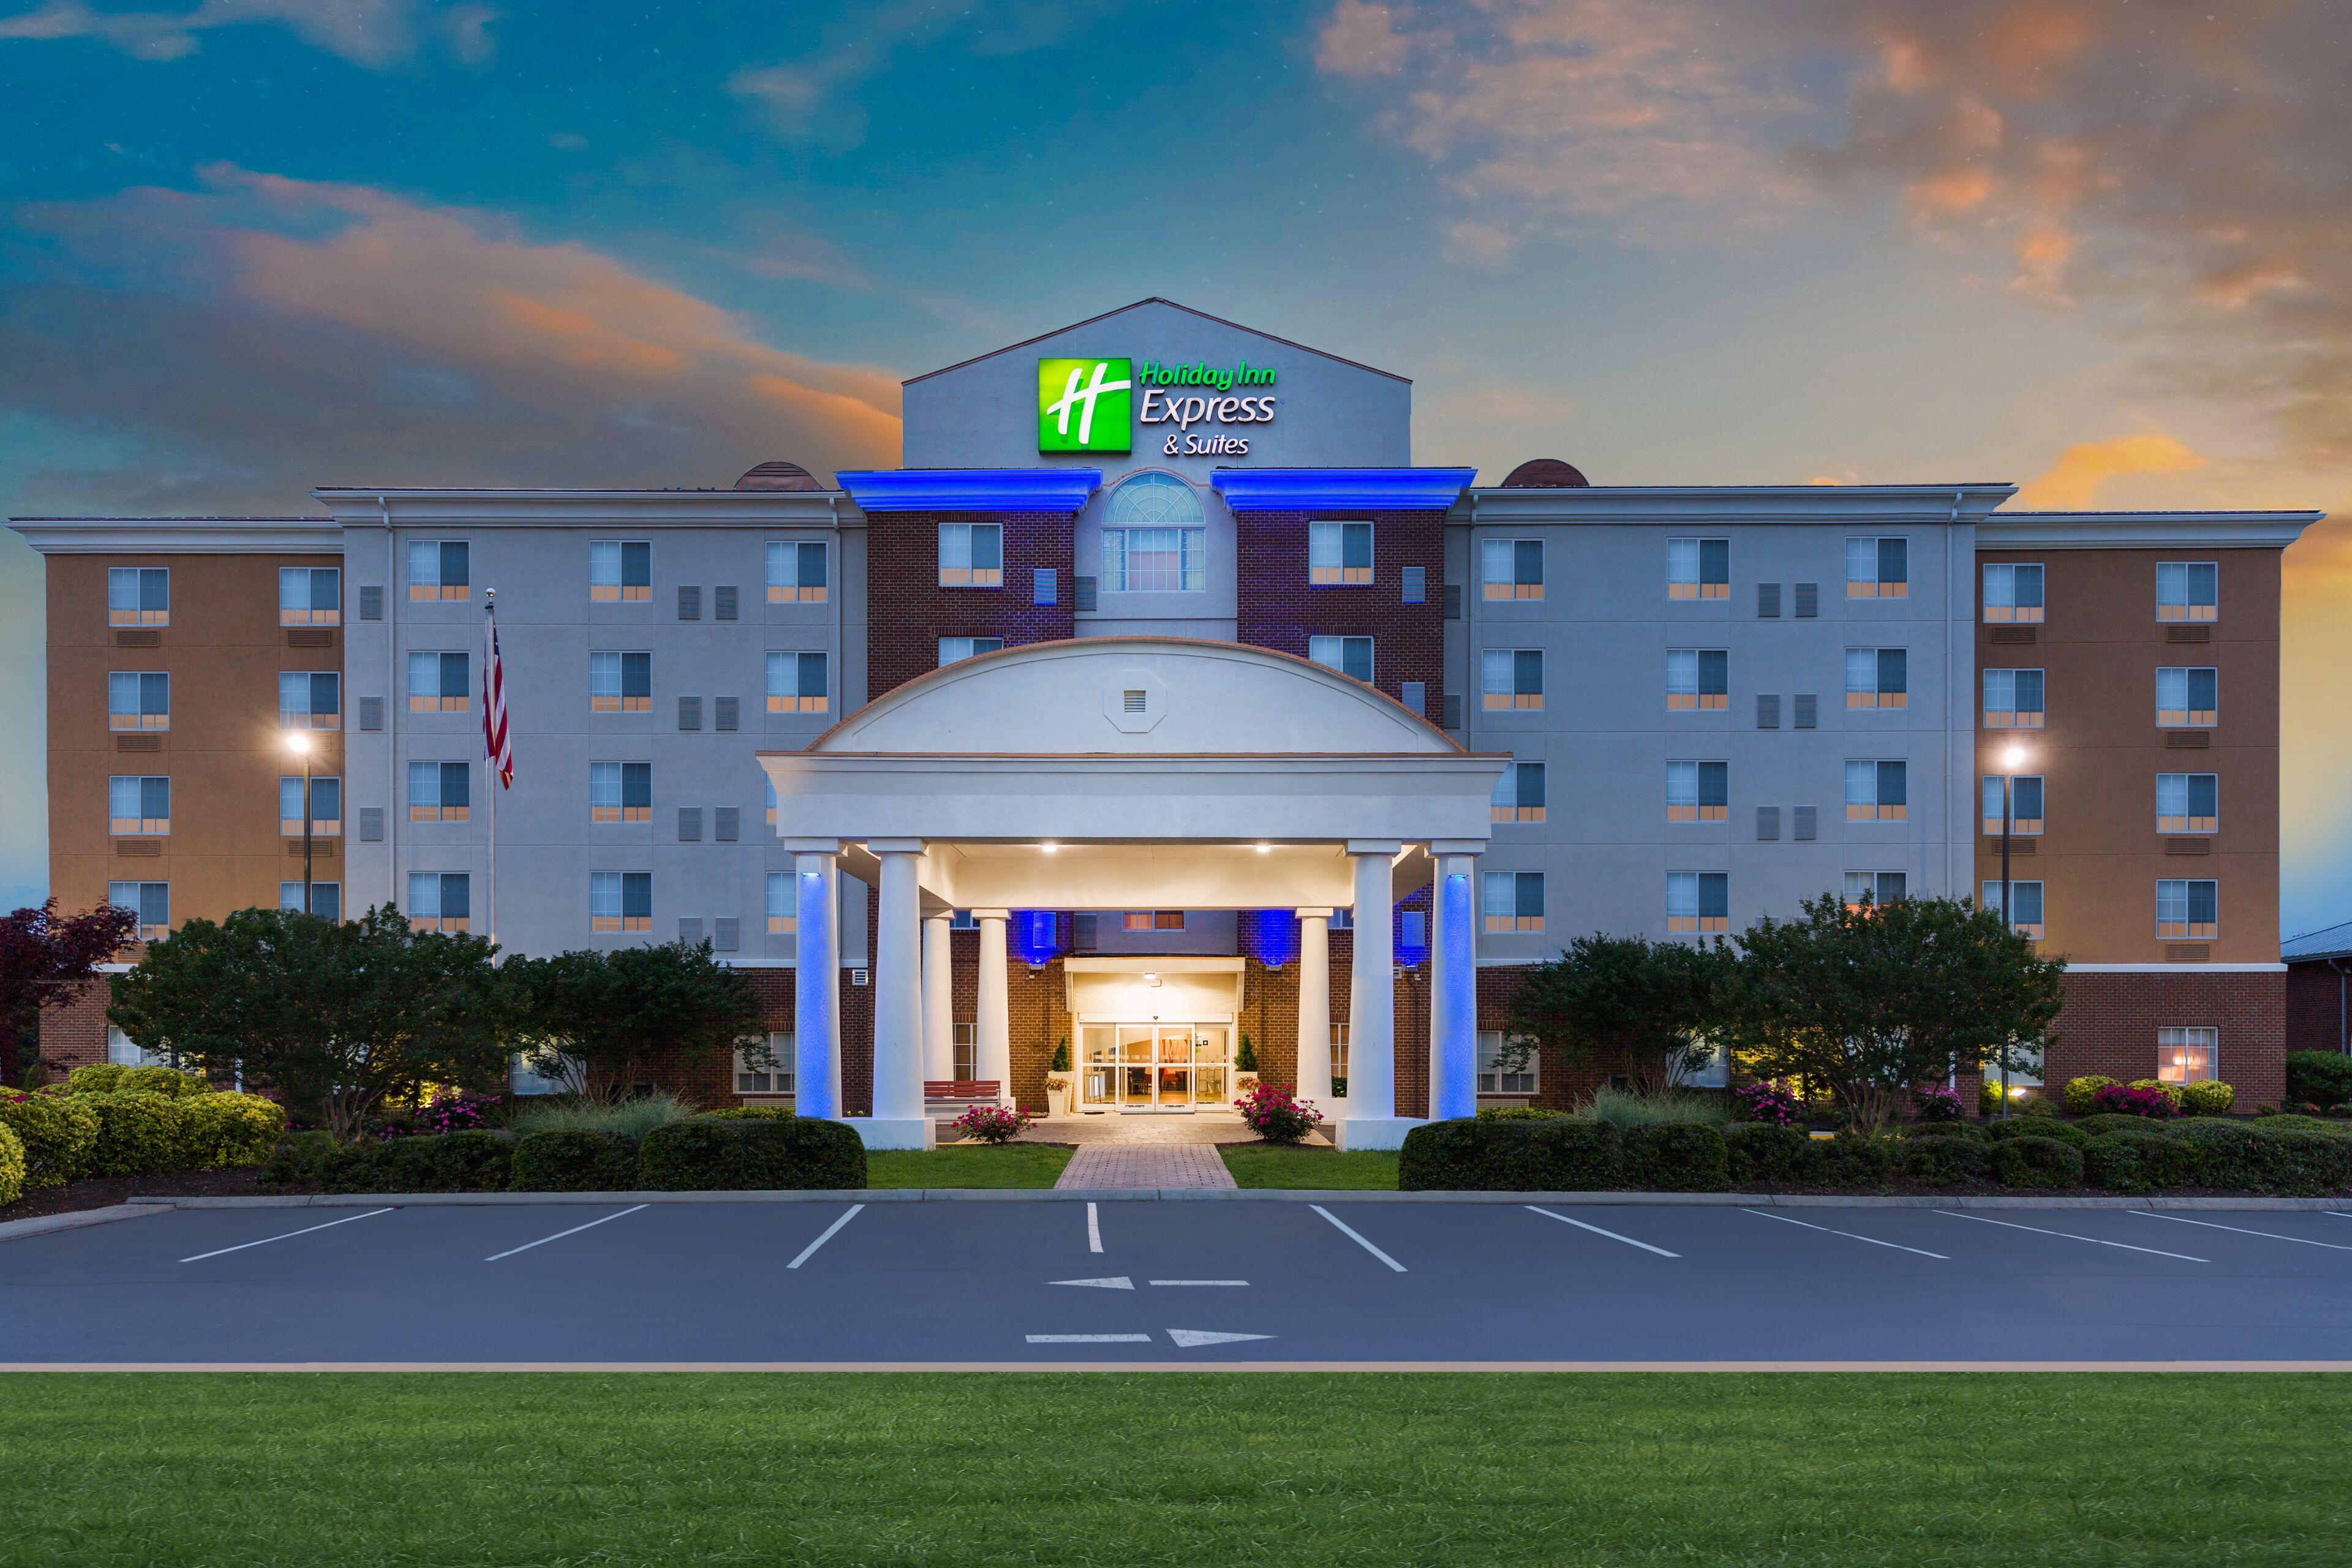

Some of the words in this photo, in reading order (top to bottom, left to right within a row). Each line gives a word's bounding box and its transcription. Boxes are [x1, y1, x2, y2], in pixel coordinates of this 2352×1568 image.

[1139, 361, 1234, 390] Holiday
[1238, 360, 1276, 385] Inn
[1047, 363, 1132, 444] H
[1140, 389, 1275, 431] Express
[1163, 434, 1179, 455] &
[1183, 434, 1249, 455] Suites
